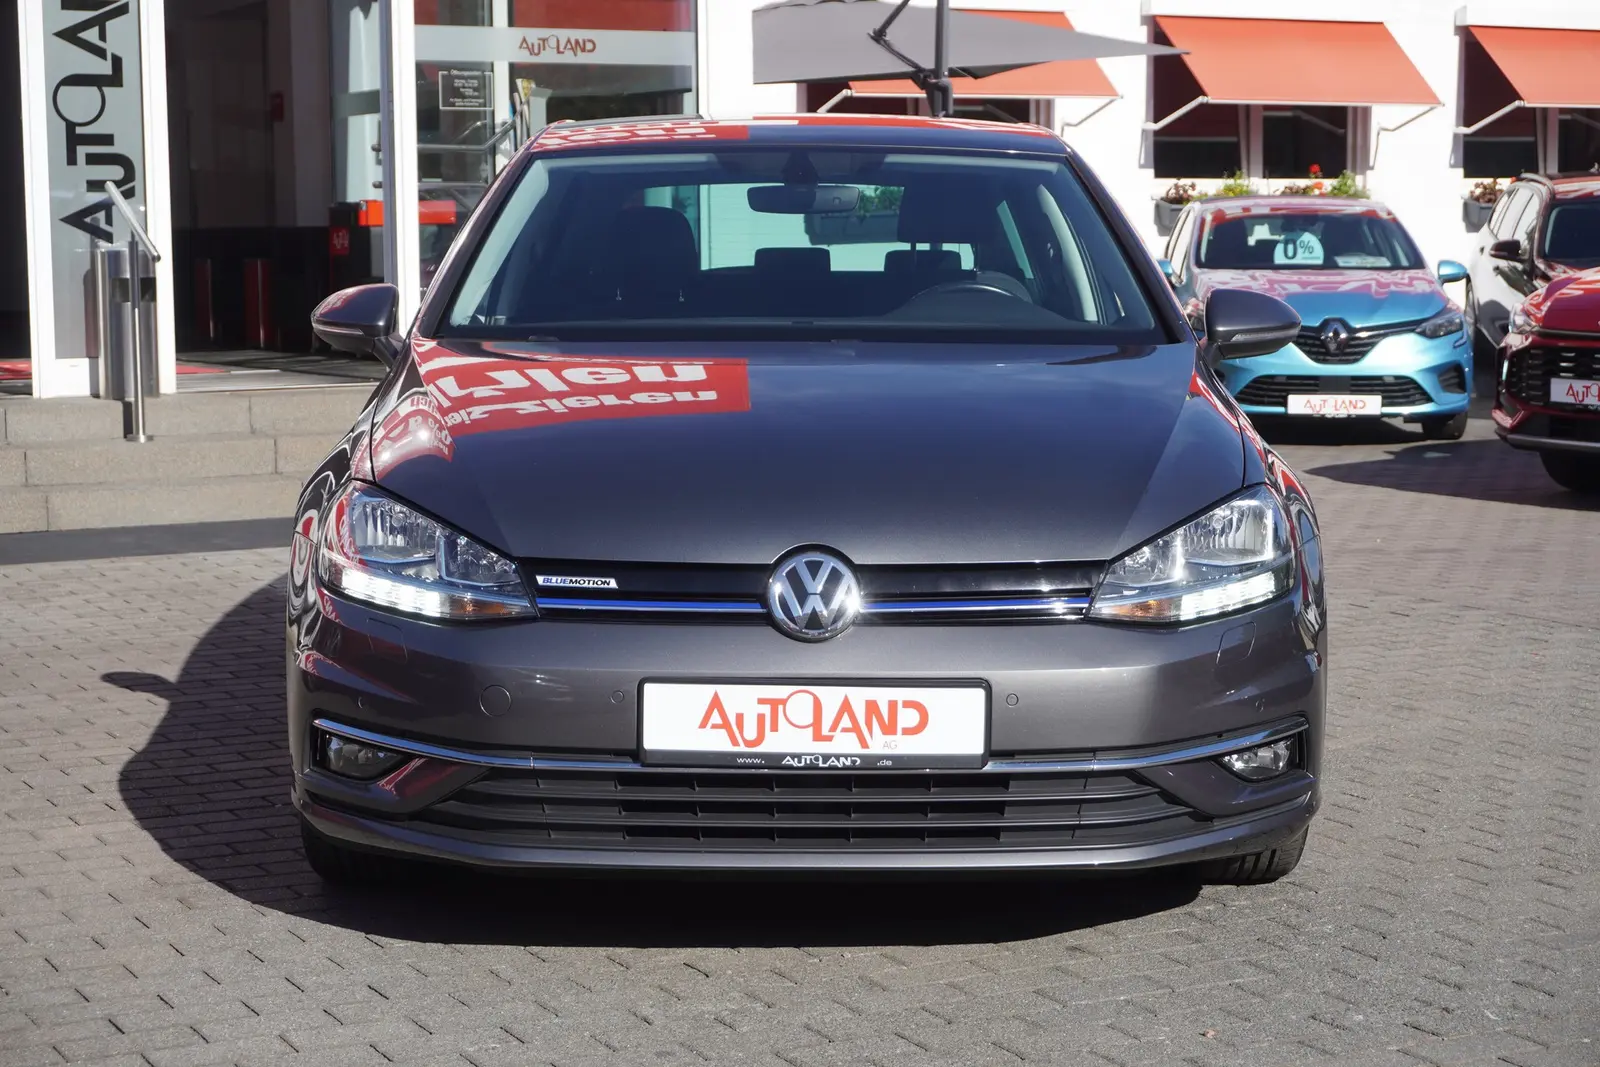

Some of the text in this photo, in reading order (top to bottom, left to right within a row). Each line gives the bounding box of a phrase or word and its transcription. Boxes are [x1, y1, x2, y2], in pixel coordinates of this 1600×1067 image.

[518, 34, 597, 57] AUTOLAND
[52, 0, 136, 244] AUTOLA
[542, 577, 611, 587] BLUEMOTION
[698, 689, 929, 749] AUTOLAND
[882, 740, 898, 750] AG
[781, 754, 861, 767] AUTOLAND
